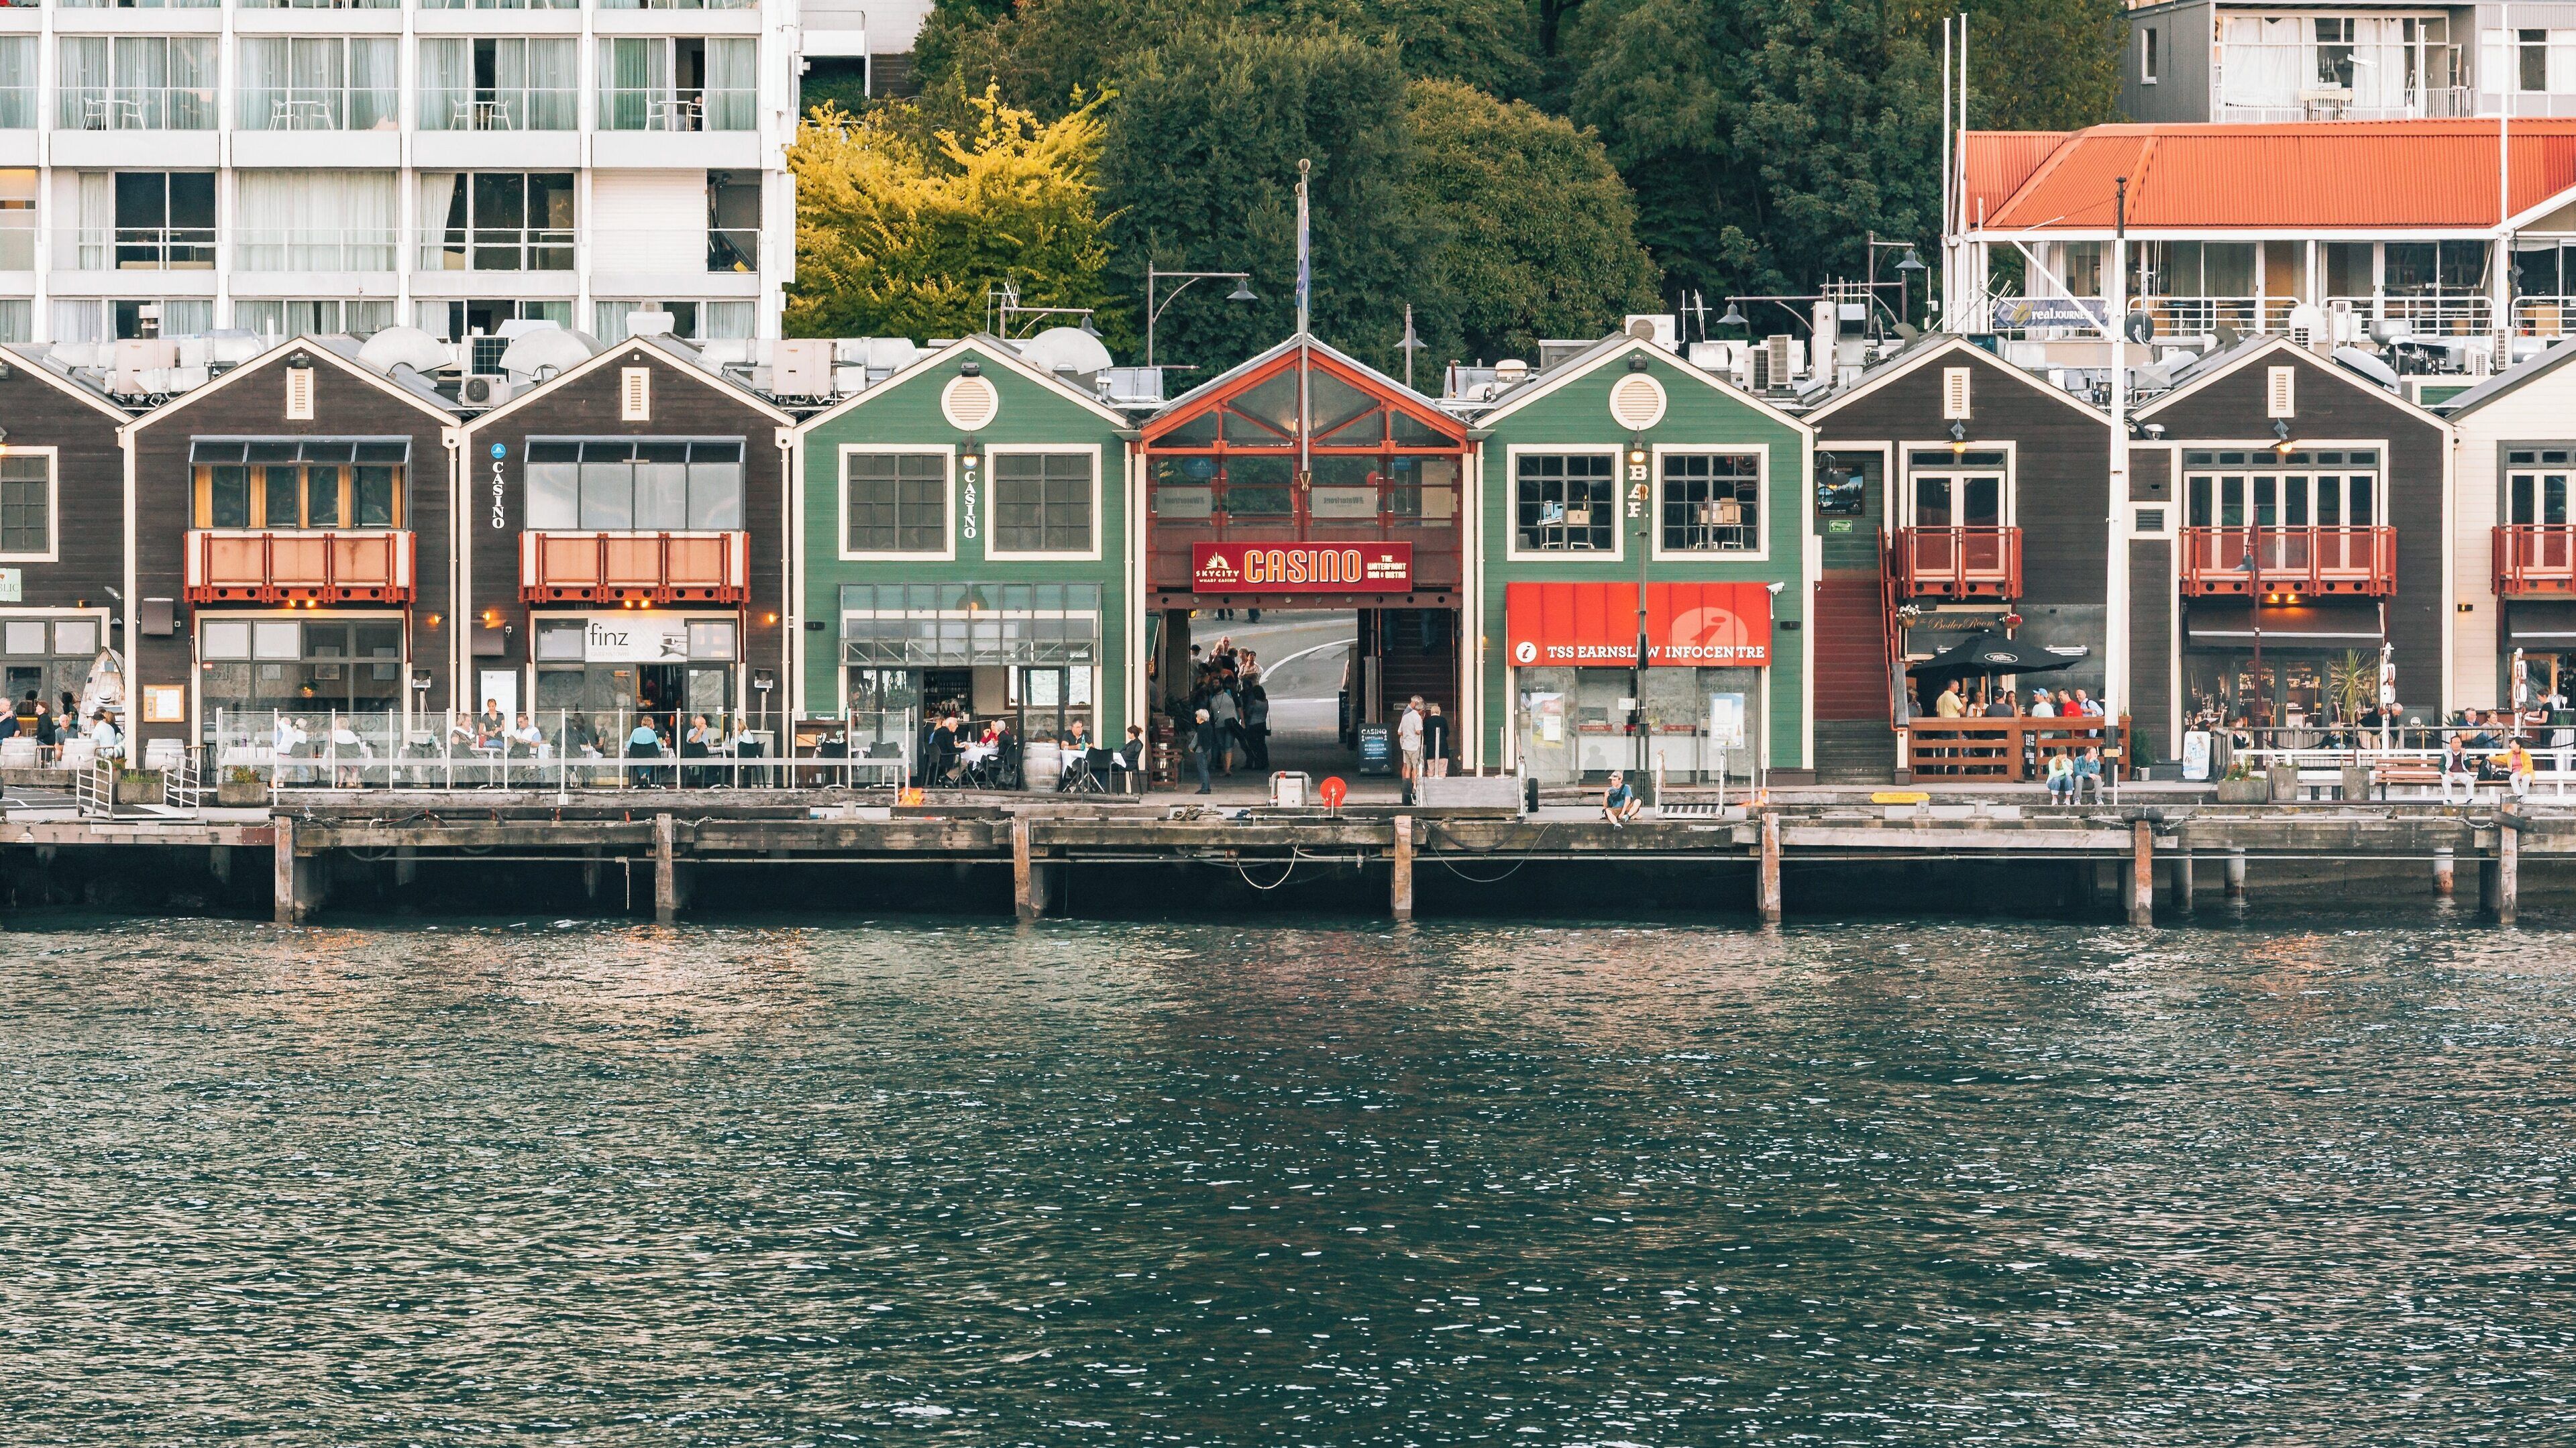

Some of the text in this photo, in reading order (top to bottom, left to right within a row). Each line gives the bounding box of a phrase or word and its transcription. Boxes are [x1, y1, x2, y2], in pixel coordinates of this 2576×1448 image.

[492, 461, 504, 528] CASINO
[964, 471, 976, 539] CASINO
[1244, 550, 1362, 583] CASINO
[1381, 555, 1393, 563] THE
[590, 622, 629, 646] finz
[1928, 617, 1963, 630] Boiler
[1964, 617, 1996, 629] Room
[1547, 646, 1574, 659] TSS
[1577, 646, 1660, 659] EARNSLW
[1665, 646, 1765, 659] INFOCENTRE
